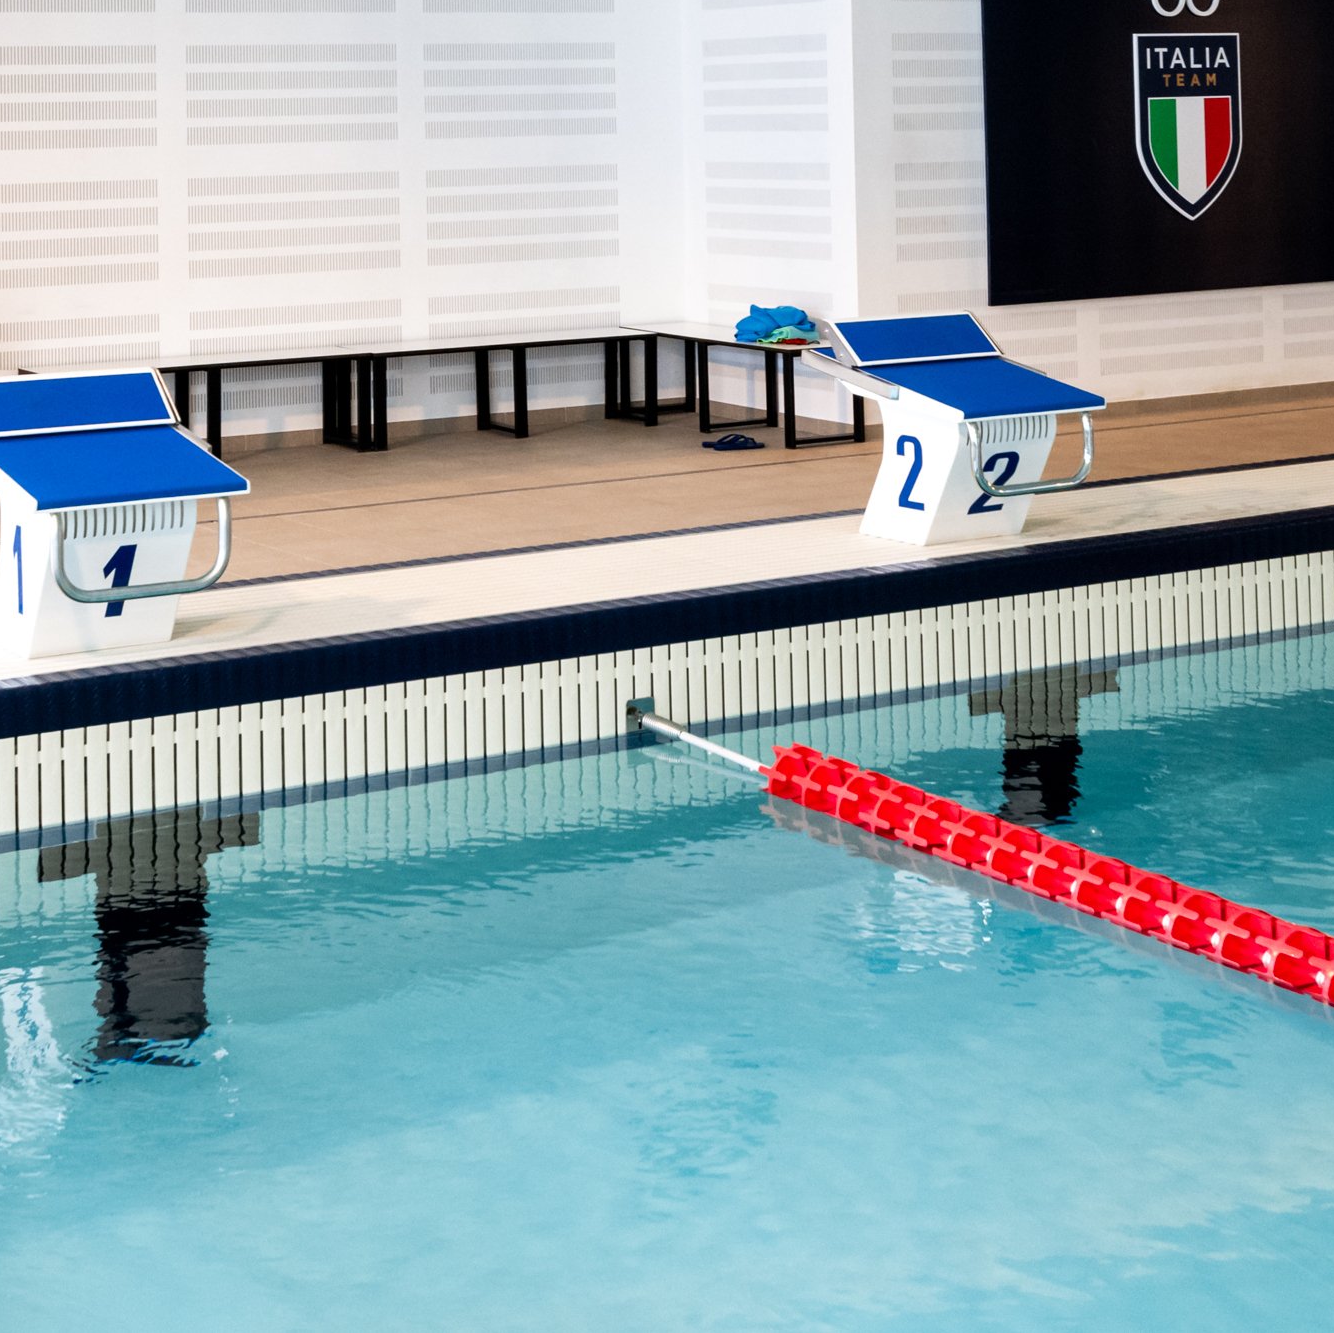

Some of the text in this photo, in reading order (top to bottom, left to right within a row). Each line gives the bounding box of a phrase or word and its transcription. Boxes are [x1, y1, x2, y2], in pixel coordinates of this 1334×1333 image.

[1146, 46, 1230, 69] ITALIA
[1162, 73, 1218, 87] TEAM
[896, 434, 925, 511] 2
[967, 451, 1020, 515] 2
[12, 525, 24, 615] 1
[103, 543, 138, 618] 1
